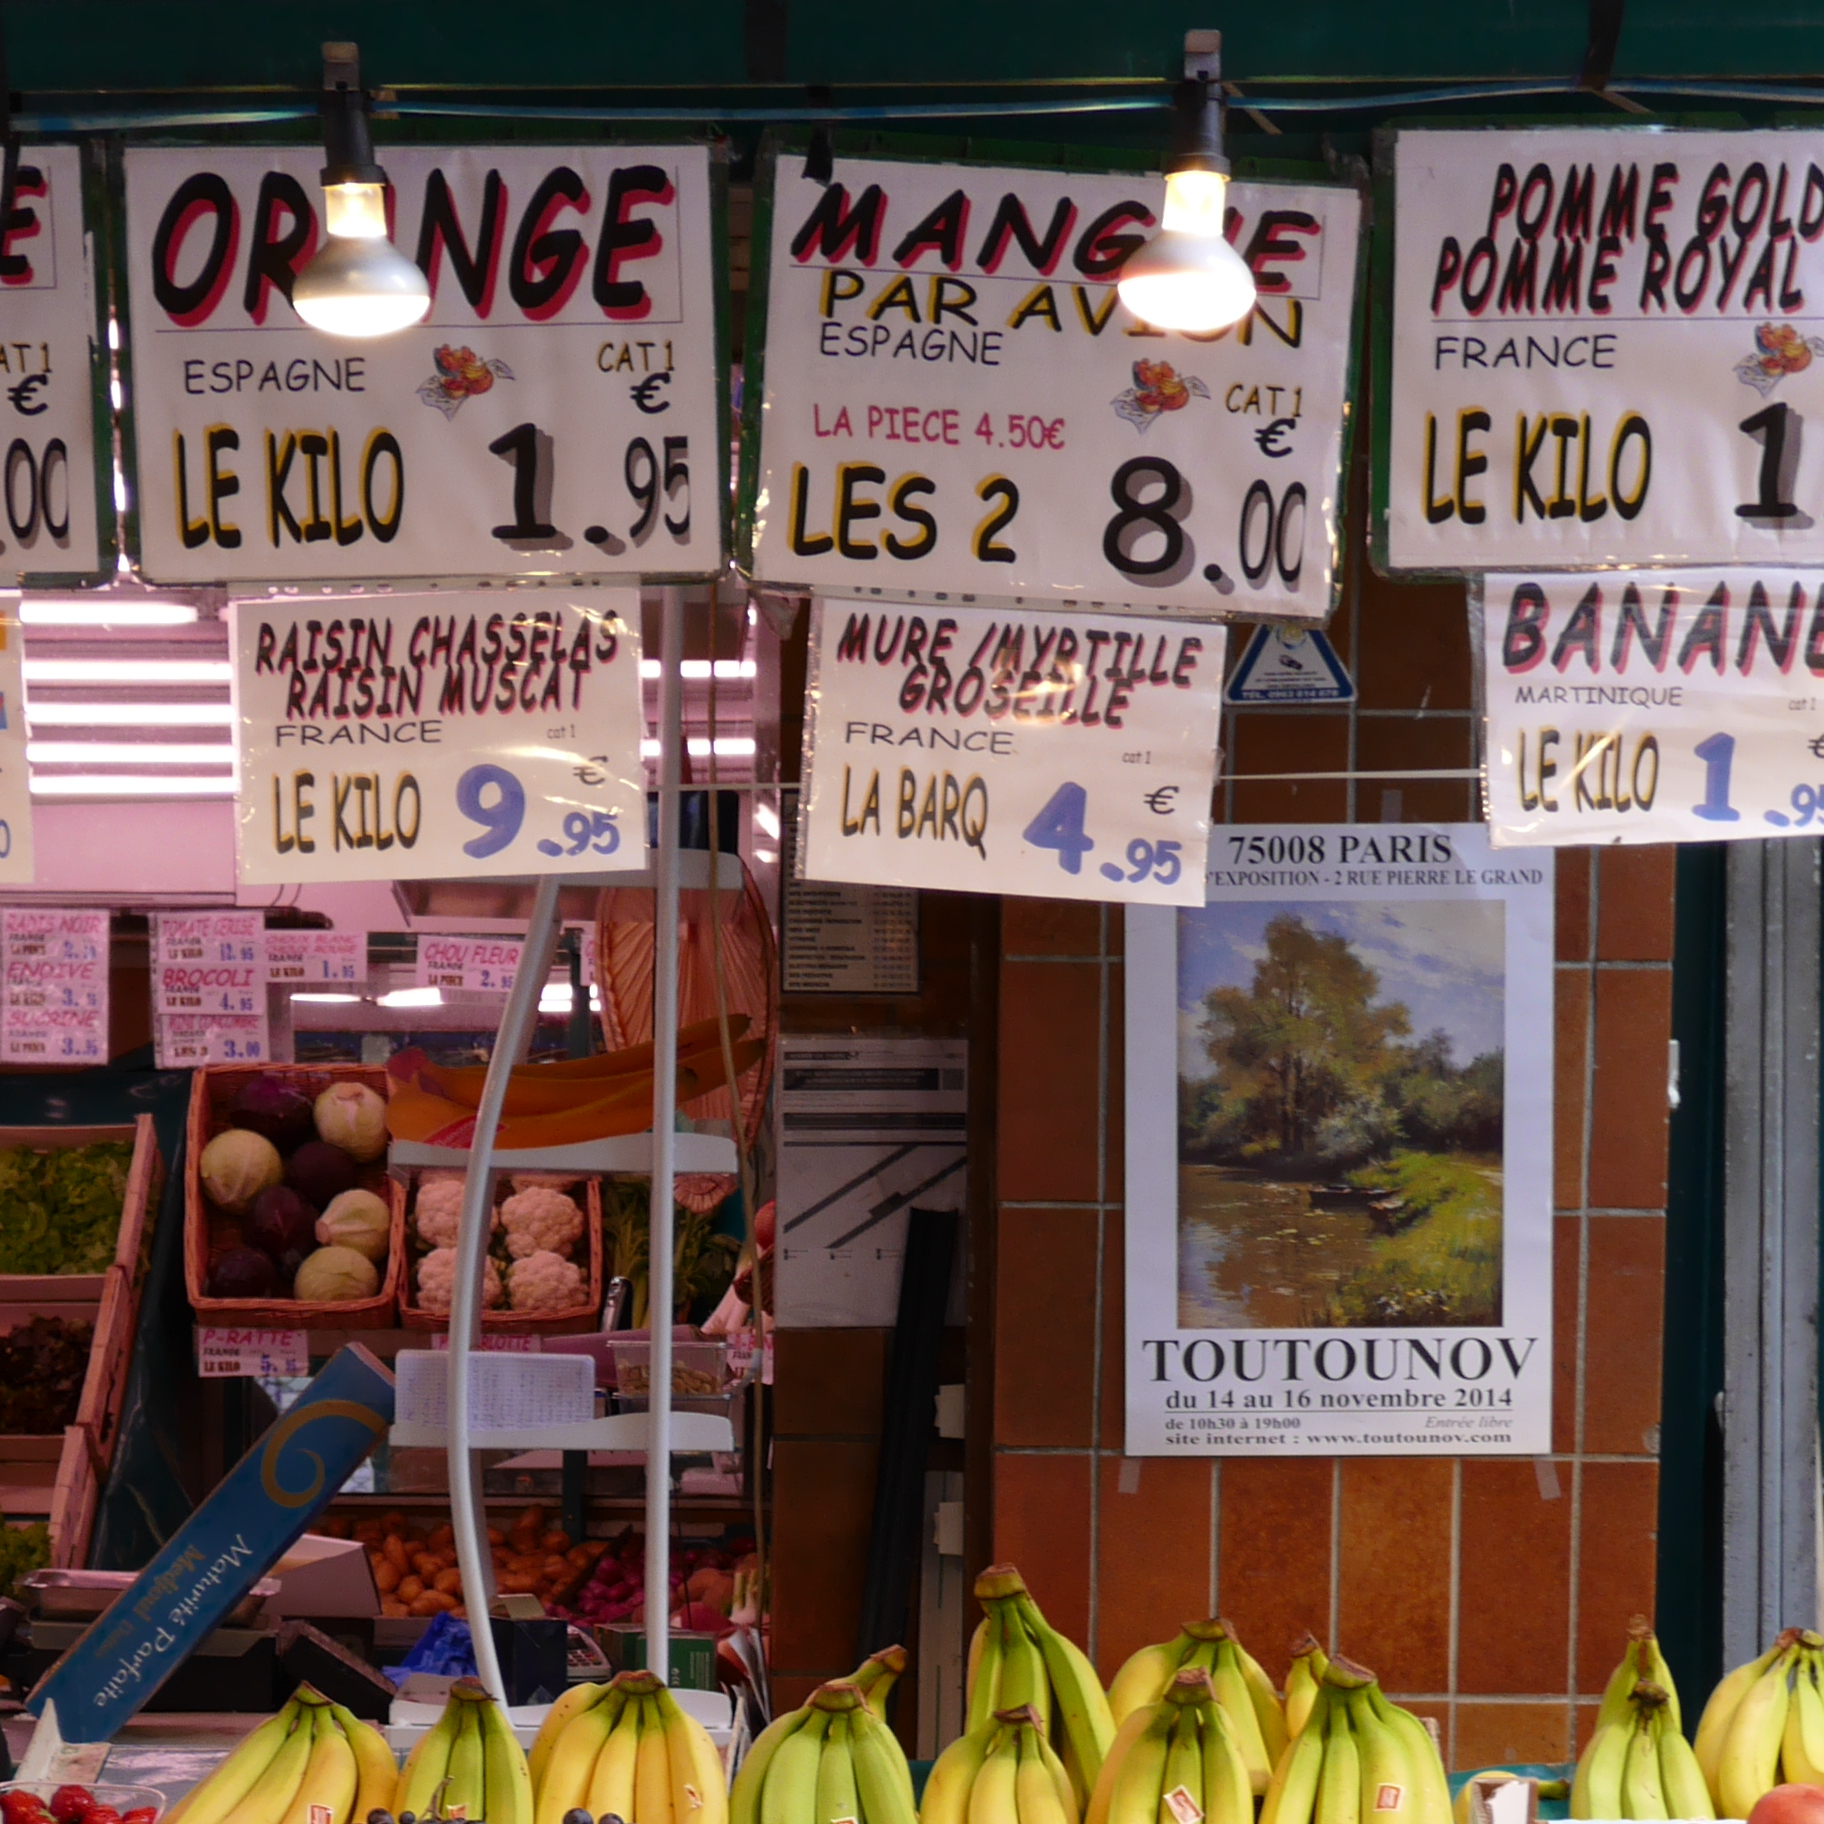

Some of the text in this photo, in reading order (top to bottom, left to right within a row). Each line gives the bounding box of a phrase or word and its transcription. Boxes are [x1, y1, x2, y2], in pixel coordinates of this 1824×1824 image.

[1488, 161, 1681, 241] POMME
[153, 165, 676, 328] ORNGE
[1431, 234, 1623, 316] POMME
[1640, 234, 1804, 316] ROYAL
[820, 268, 1302, 349] PAR AVN
[820, 322, 1003, 365] ESPAGNE
[1436, 334, 1618, 371] FRANCE
[184, 356, 366, 395] ESPAGNE
[813, 404, 1065, 450] LA PIECE 4.50€
[174, 422, 241, 549] LE
[265, 425, 405, 549] KILO
[1422, 406, 1492, 525] LE
[1512, 409, 1652, 525] KILO
[789, 460, 937, 560] LES
[973, 473, 1020, 564] 2
[255, 609, 620, 675] RAISIN CHASSELAS
[837, 613, 958, 667] MURE
[285, 658, 587, 721] RAISIN MUSCAT
[899, 662, 1135, 728] GROSEILLE
[1515, 686, 1683, 708] MARTINIQUE
[275, 719, 443, 747] FRANCE
[845, 721, 1015, 755] FRANCE
[1518, 725, 1560, 812] LE
[1574, 729, 1659, 813] KILO
[271, 768, 316, 854] LE
[331, 768, 421, 853] KILO
[840, 763, 1182, 886] LA BARQ 4.95
[1228, 835, 1452, 865] 75008 PARIS
[1334, 868, 1543, 885] 2 RUE PIERRE LE GRAND
[7, 962, 95, 980] ENDIVE
[424, 942, 519, 965] CHOU FLEUR
[163, 968, 255, 988] BROCOLI
[7, 1010, 96, 1027] SUCRINE
[1142, 1338, 1538, 1382] TOUTOUNOV
[1165, 1388, 1512, 1410] du 14 au 16 novembre 2014
[1165, 1418, 1182, 1430] de
[1189, 1418, 1235, 1430] 10h30
[1255, 1417, 1301, 1430] 19h00
[1165, 1432, 1512, 1446] site internet www.toutounov.com
[1425, 1415, 1512, 1430] Entrée libre
[169, 1533, 254, 1627] Maturité
[93, 1626, 176, 1707] Parfaite
